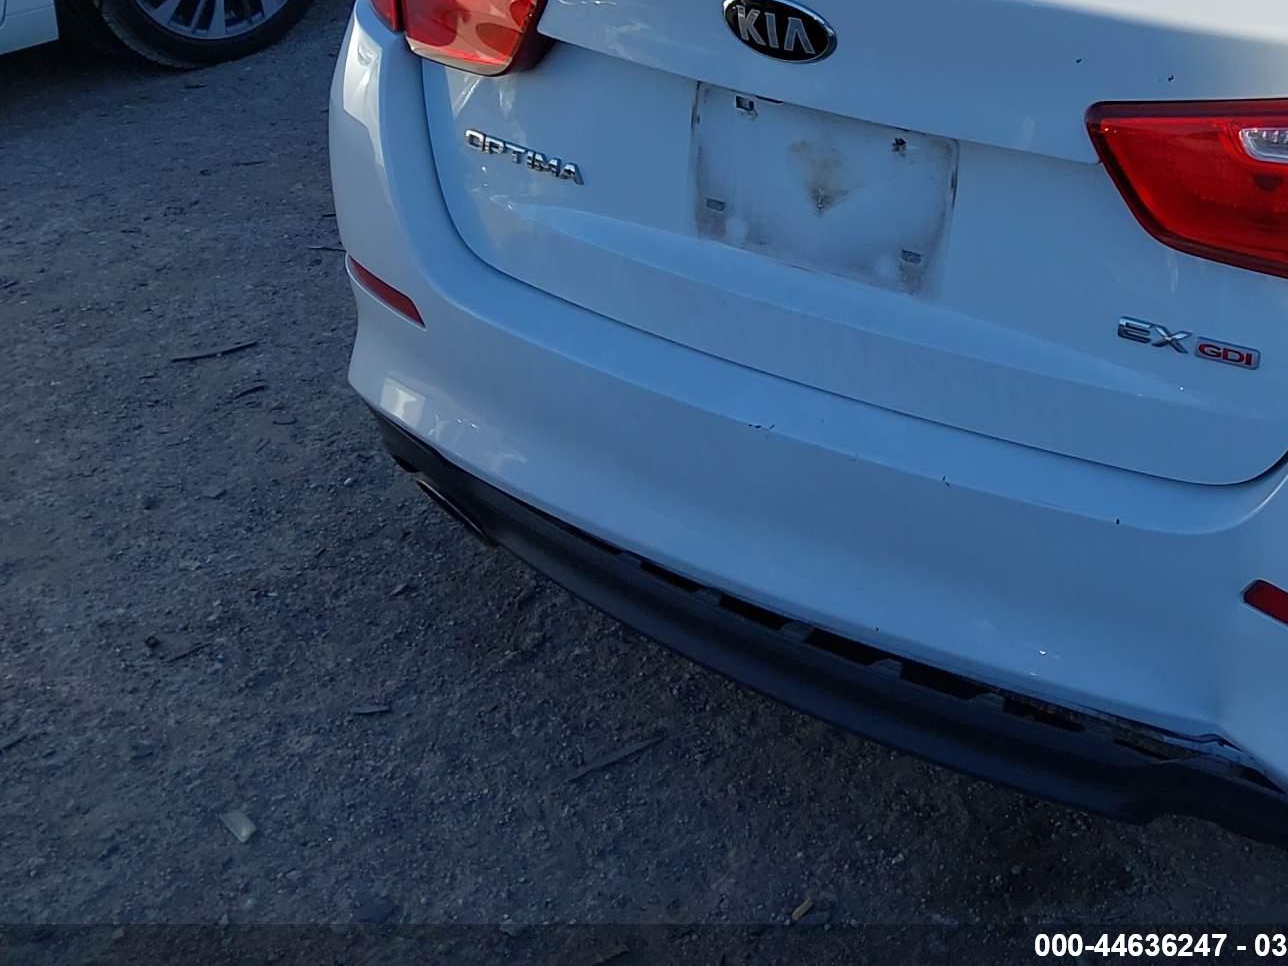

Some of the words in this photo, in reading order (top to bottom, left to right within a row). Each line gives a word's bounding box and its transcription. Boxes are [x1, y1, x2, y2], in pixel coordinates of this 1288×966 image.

[736, 4, 817, 55] KIA
[464, 128, 584, 185] OPTIMA
[1117, 315, 1193, 355] EX
[1198, 343, 1253, 366] GDI
